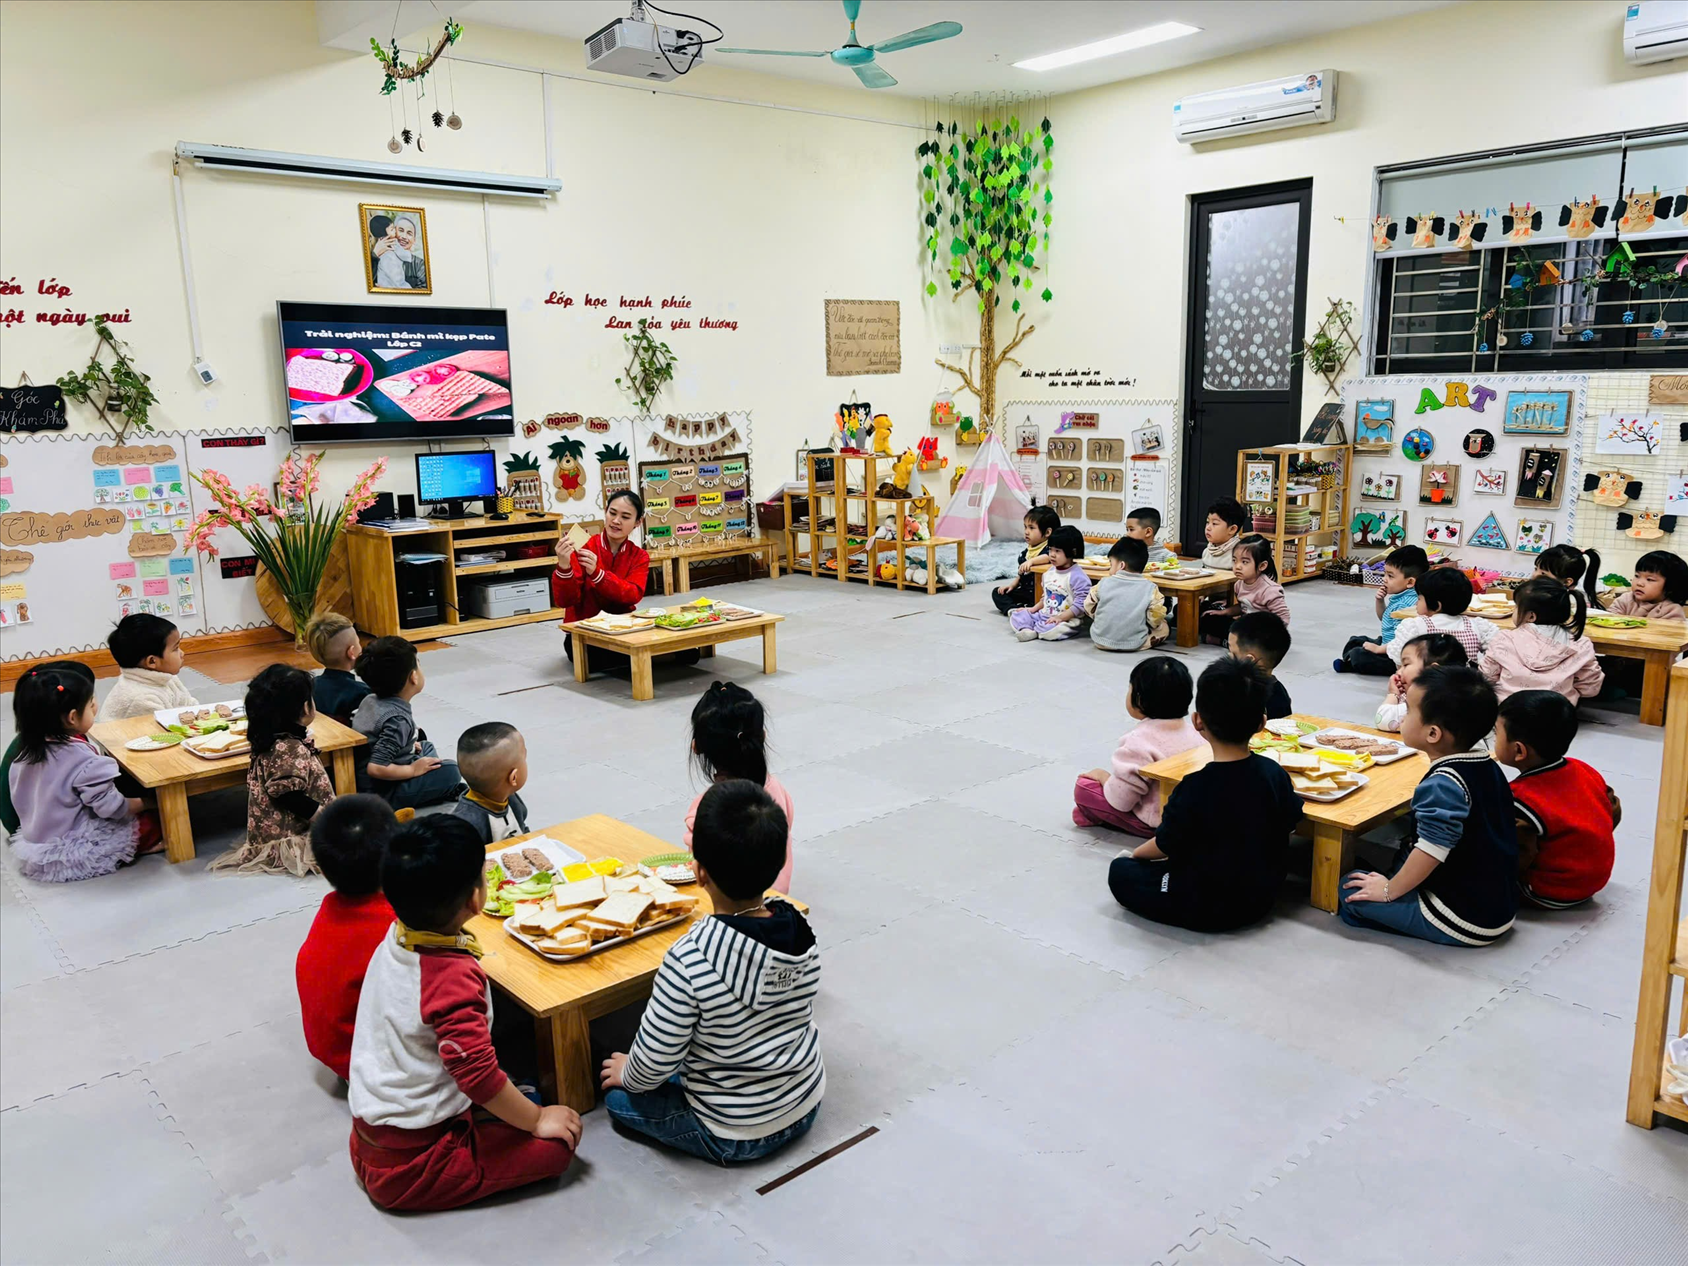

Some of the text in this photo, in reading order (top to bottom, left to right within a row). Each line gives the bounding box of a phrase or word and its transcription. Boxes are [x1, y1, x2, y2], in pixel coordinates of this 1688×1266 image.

[38, 278, 73, 299] lớp
[544, 291, 692, 310] Lớp học hạnh phúc
[36, 308, 87, 326] ngày
[604, 316, 633, 329] Lan
[671, 319, 691, 331] yêu
[699, 317, 738, 331] thương
[11, 390, 40, 409] Góc
[1414, 382, 1498, 415] ART
[40, 408, 67, 426] Phá
[547, 415, 579, 427] ngoan
[667, 414, 726, 433] happy
[203, 439, 224, 448] CON
[221, 560, 242, 569] CON
